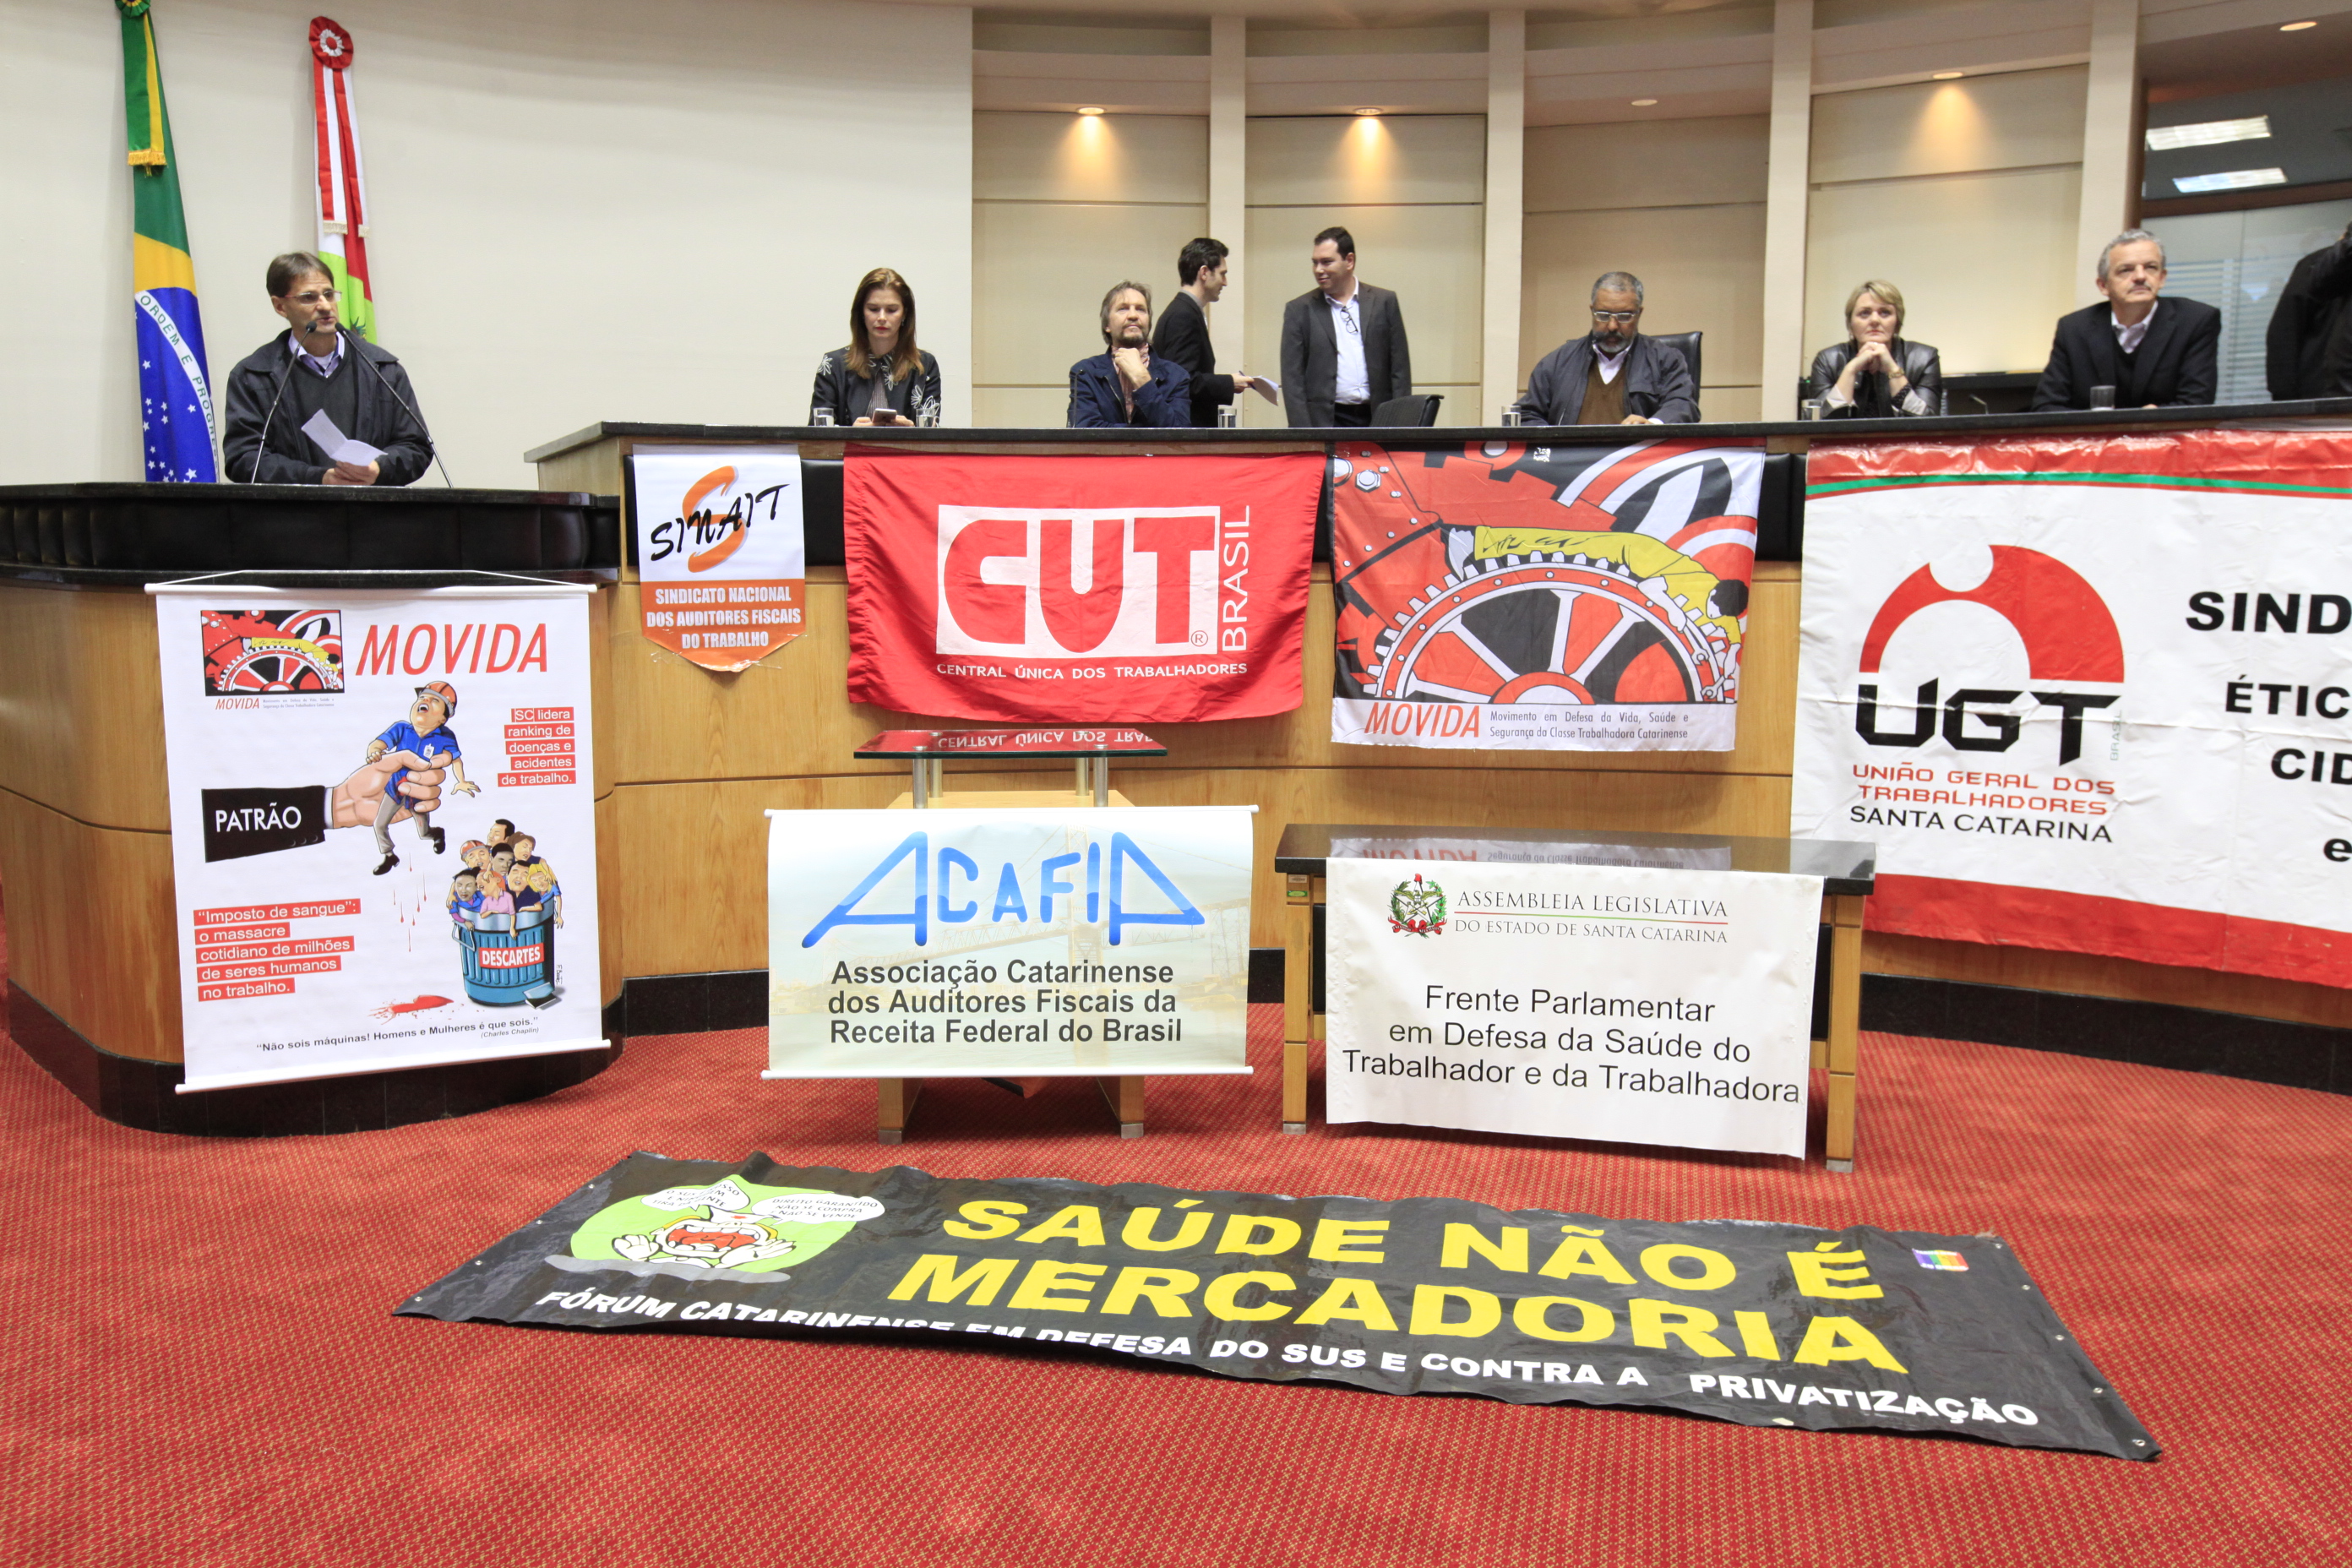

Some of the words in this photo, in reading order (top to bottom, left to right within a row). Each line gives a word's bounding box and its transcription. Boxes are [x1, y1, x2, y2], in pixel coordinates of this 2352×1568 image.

[140, 295, 180, 346] ORDEM
[181, 354, 193, 366] E
[651, 483, 790, 562] SINAIT
[943, 515, 1217, 653] CUT
[1222, 504, 1250, 651] BRASIL
[656, 587, 726, 604] SINDICATO
[728, 586, 792, 602] NACIONAL
[646, 611, 674, 628] DOS
[677, 609, 749, 627] AUDITORES
[752, 608, 801, 624] FISCAIS
[2186, 591, 2352, 634] SIND
[356, 623, 547, 676] MOVIDA
[682, 633, 700, 649] DO
[703, 631, 769, 648] TRABALHO
[935, 662, 1007, 678] CENTRAL
[1015, 664, 1064, 680] ÚNICA
[1072, 667, 1106, 678] DOS
[1114, 662, 1248, 678] TRABALHADORES
[215, 698, 259, 710] MOVIDA
[2224, 674, 2352, 719] ÉTIC
[515, 710, 534, 721] SC
[537, 709, 570, 720] lidera
[1364, 702, 1480, 738] MOVIDA
[1489, 710, 1538, 723] Movimento
[1544, 714, 1559, 723] em
[1565, 710, 1594, 724] Defesa
[1600, 710, 1613, 724] da
[1619, 710, 1642, 725] Vida,
[1648, 710, 1677, 723] Saúde
[1683, 715, 1689, 724] e
[1855, 677, 2121, 766] UGT
[508, 726, 553, 738] ranking
[556, 725, 571, 735] de
[1489, 726, 1534, 741] Segurança
[1536, 727, 1549, 738] da
[1549, 727, 1576, 738] Classe
[1577, 727, 1636, 740] Trabalhadora
[1637, 727, 1689, 739] Catarinense
[509, 742, 561, 754] doenças
[564, 743, 572, 751] e
[514, 757, 572, 769] acidentes
[2271, 748, 2352, 785] CID
[501, 775, 517, 786] de
[520, 772, 572, 784] trabalho.
[1852, 761, 1935, 782] UNIÃO
[1946, 770, 2039, 790] GERAL
[2052, 777, 2115, 795] DOS
[1858, 785, 2107, 816] TRABALHADORES
[215, 803, 302, 832] PATRÃO
[1849, 805, 1945, 830] SANTA
[1953, 813, 2113, 843] CATARINA
[802, 831, 1205, 949] ACAFIA
[1457, 890, 1586, 912] ASSEMBLEIA
[1592, 894, 1729, 918] LEGISLATIVA
[198, 907, 265, 924] “Imposto
[270, 906, 288, 918] de
[292, 901, 357, 917] sangue”:
[199, 932, 210, 943] o
[214, 926, 286, 942] massacre
[1455, 918, 1480, 934] DO
[1486, 920, 1551, 935] ESTADO
[1555, 922, 1577, 936] DE
[1583, 923, 1636, 939] SANTA
[1641, 925, 1728, 944] CATARINA
[200, 946, 268, 961] cotidiano
[272, 944, 291, 956] de
[295, 939, 351, 954] milhões
[482, 946, 541, 966] DESCARTES
[202, 968, 220, 981] de
[225, 965, 266, 978] seres
[270, 959, 337, 975] humanos
[830, 960, 998, 990] Associação
[1006, 959, 1173, 984] Catarinense
[203, 988, 221, 999] no
[226, 981, 290, 997] trabalho.
[828, 989, 881, 1014] dos
[889, 989, 1026, 1014] Auditores
[1036, 988, 1135, 1013] Fiscais
[1143, 988, 1177, 1013] da
[1425, 984, 1520, 1012] Frente
[1531, 988, 1716, 1023] Parlamentar
[288, 1039, 311, 1049] sois
[314, 1032, 370, 1047] máquinas!
[373, 1029, 417, 1041] Homens
[429, 1023, 476, 1035] Mulheres
[479, 1021, 485, 1030] é
[488, 1021, 507, 1031] que
[481, 1030, 509, 1039] (Charles
[511, 1026, 539, 1035] Chaplin)
[830, 1020, 936, 1044] Receita
[945, 1019, 1048, 1043] Federal
[1058, 1019, 1094, 1043] do
[1102, 1018, 1182, 1043] Brasil
[1389, 1025, 1433, 1045] em
[1444, 1021, 1548, 1050] Defesa
[1557, 1026, 1593, 1053] da
[1605, 1027, 1702, 1060] Saúde
[1712, 1034, 1751, 1064] do
[1342, 1048, 1515, 1086] Trabalhador
[1524, 1065, 1542, 1086] e
[1552, 1062, 1588, 1089] da
[1598, 1063, 1800, 1104] Trabalhadora
[816, 1199, 879, 1208] GARANTIDO
[942, 1198, 1391, 1264] SAÚDE
[1440, 1222, 1736, 1292] NÃO
[1786, 1241, 1885, 1300] É
[887, 1254, 1909, 1375] MERCADORIA
[535, 1286, 676, 1320] FÓRUM
[1036, 1329, 1192, 1357] DEFESA
[1209, 1339, 1269, 1358] DO
[1281, 1342, 1368, 1369] SUS
[1380, 1352, 1407, 1373] E
[1421, 1352, 1604, 1386] CONTRA
[1616, 1366, 1649, 1386] A
[1690, 1373, 2039, 1426] PRIVATIZAÇÃO
